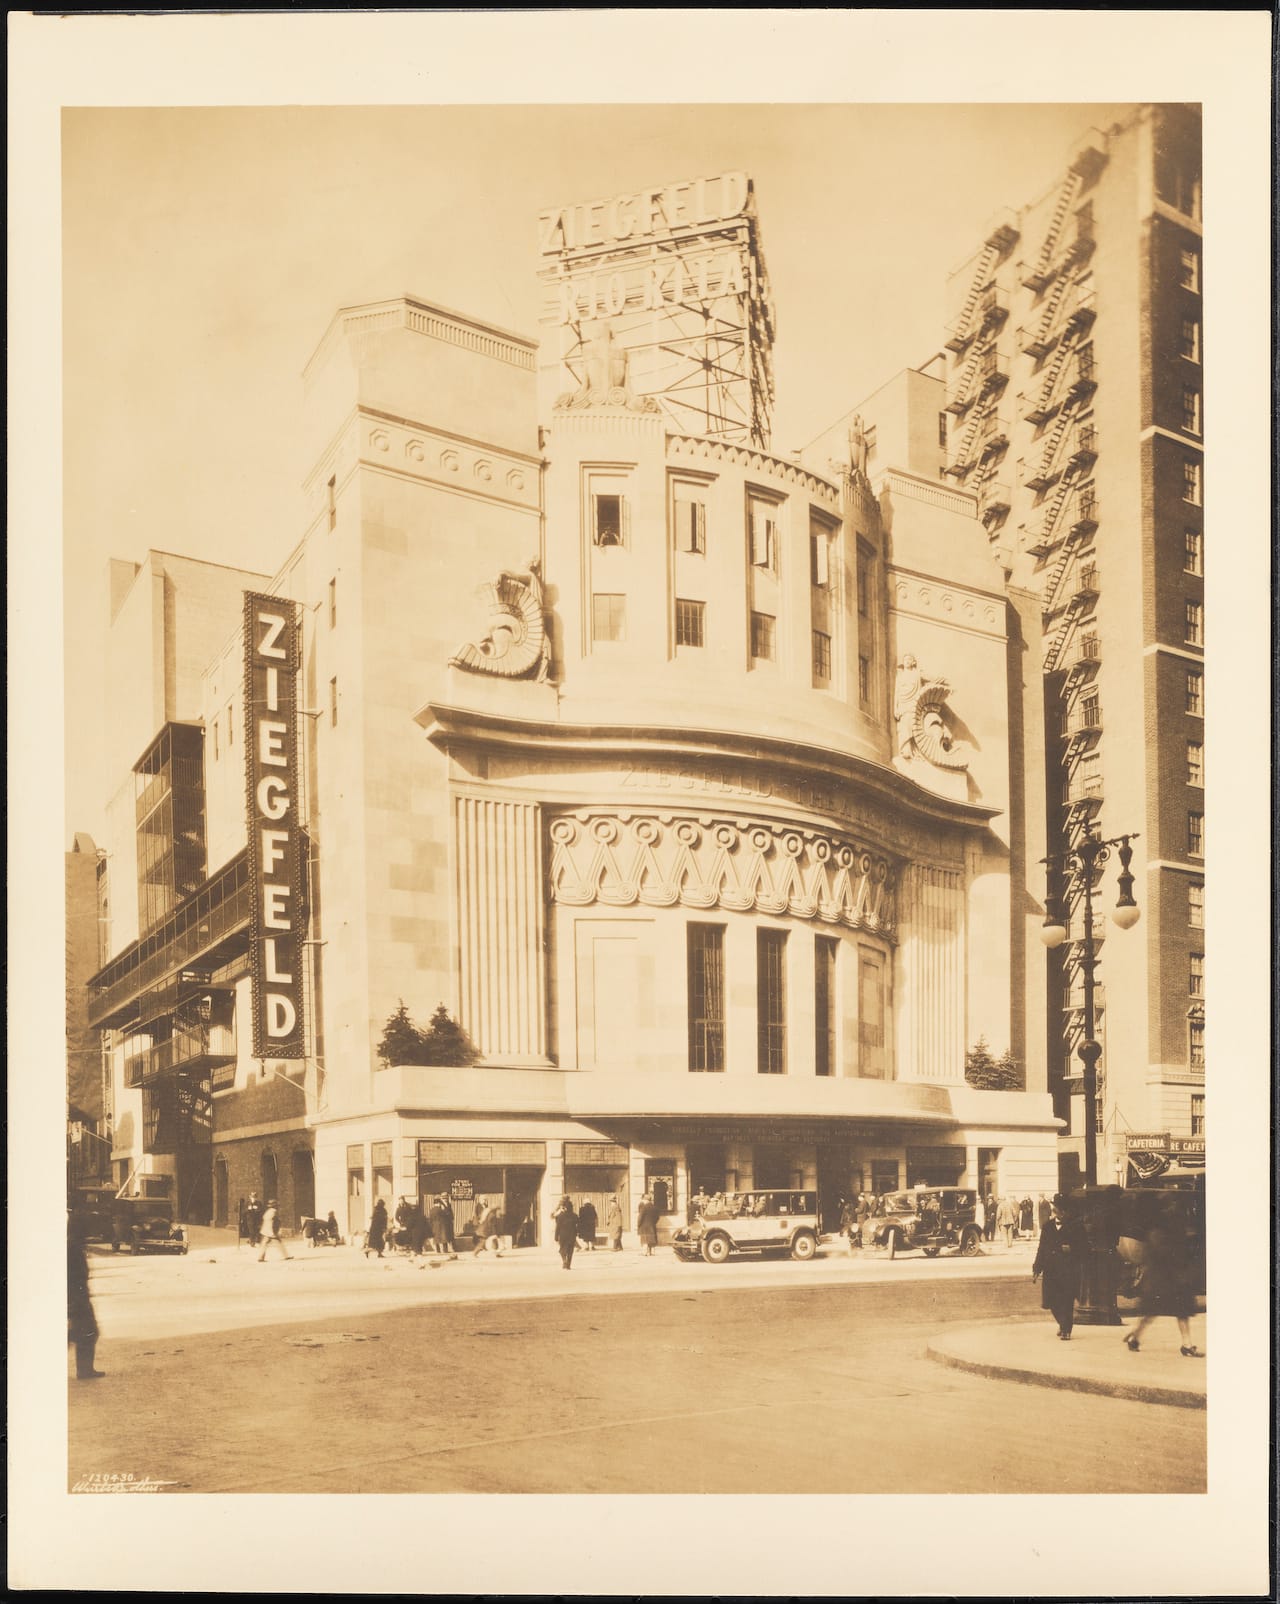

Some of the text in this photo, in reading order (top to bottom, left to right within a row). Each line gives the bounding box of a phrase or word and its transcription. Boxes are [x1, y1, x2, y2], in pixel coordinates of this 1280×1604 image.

[537, 169, 749, 254] ZIEGFELD
[559, 271, 626, 323] RIO
[619, 766, 774, 799] ZIEGFELD
[257, 612, 297, 1039] ZIEGFELD
[1128, 1139, 1166, 1149] CAFETERIA
